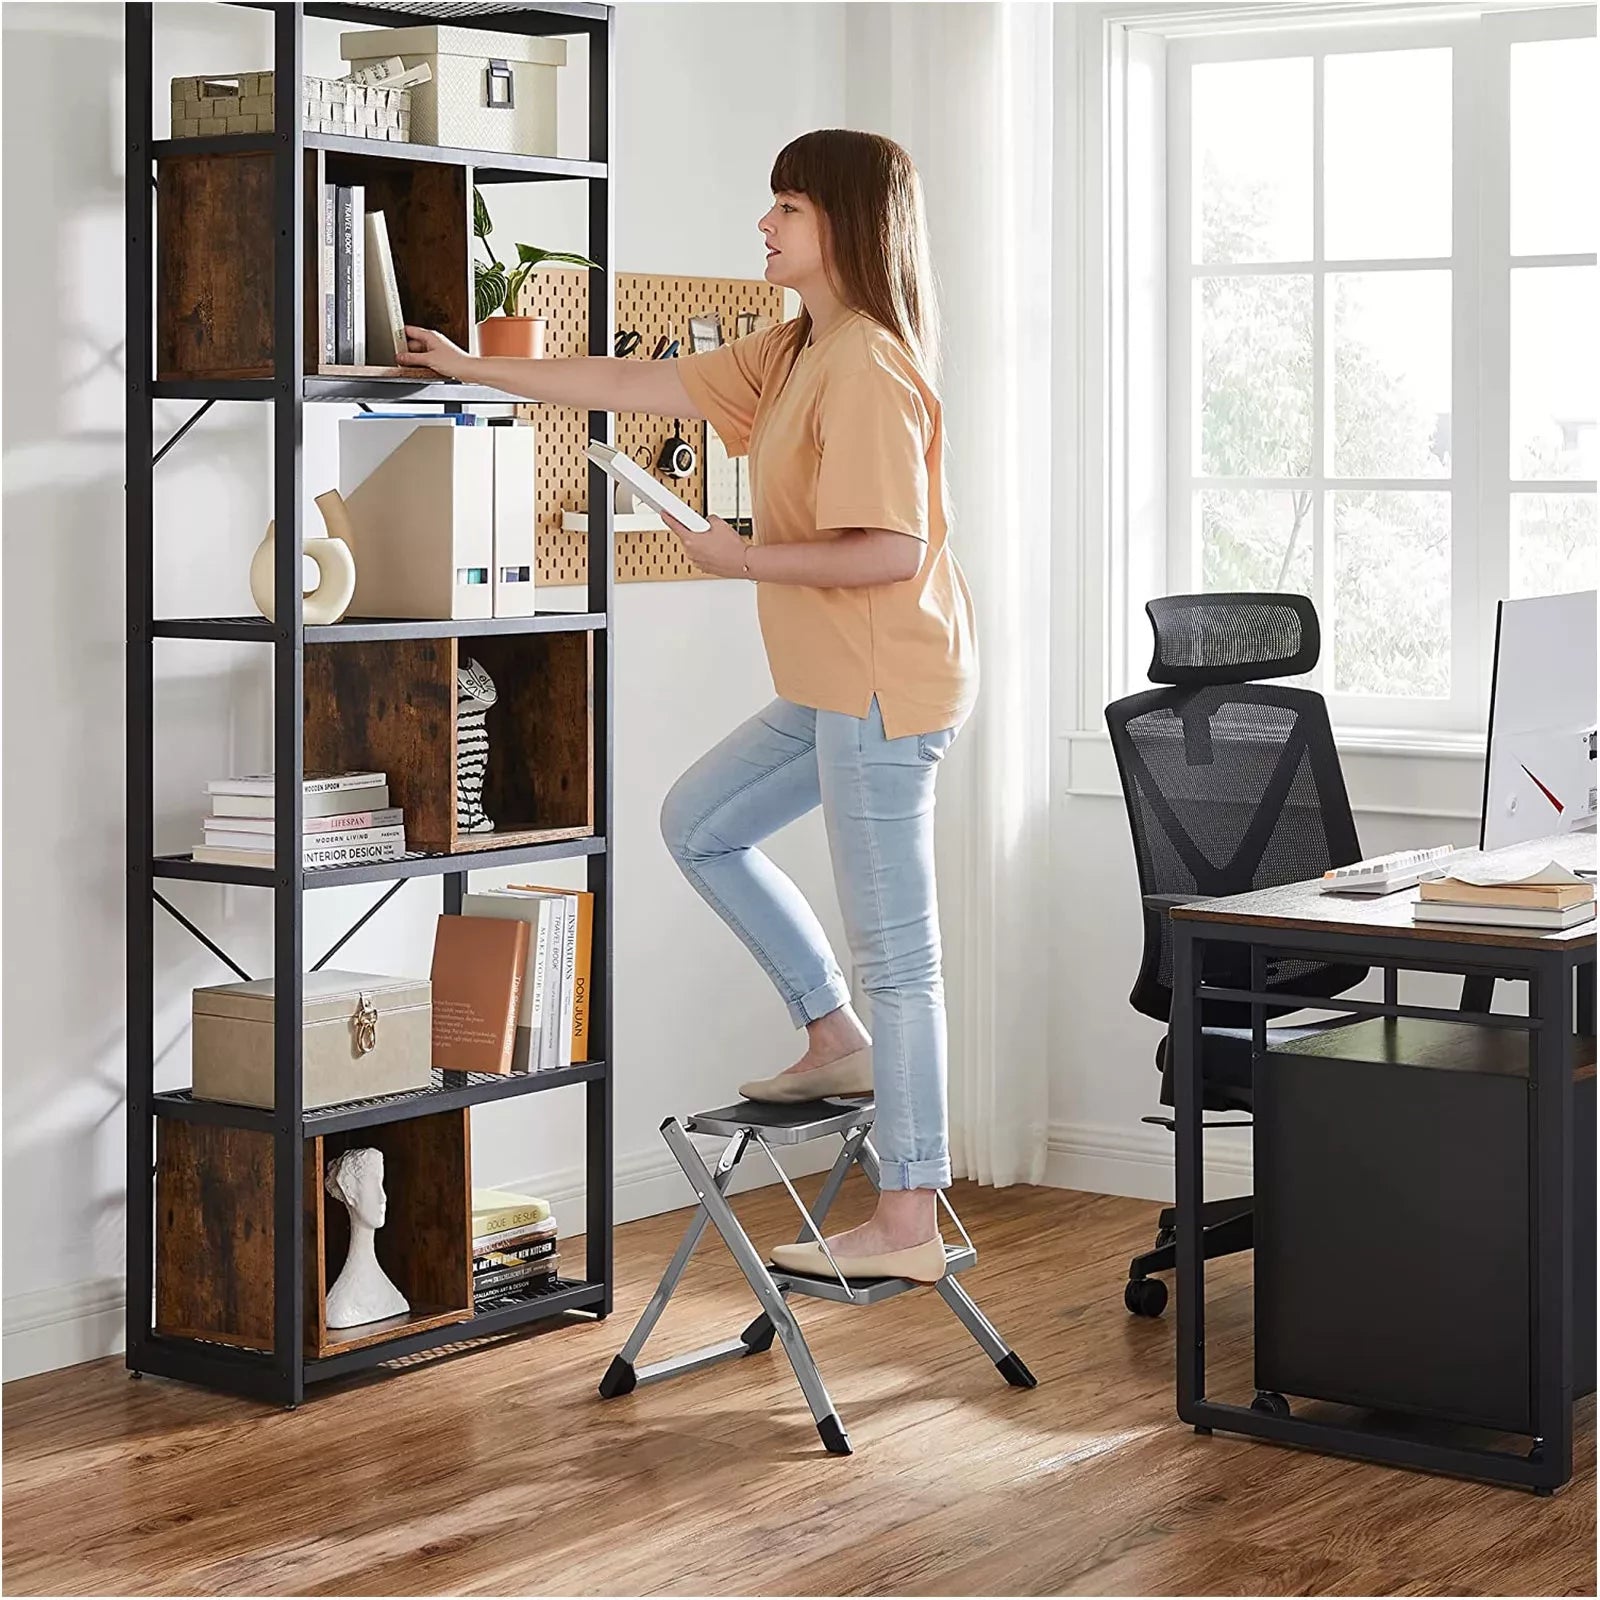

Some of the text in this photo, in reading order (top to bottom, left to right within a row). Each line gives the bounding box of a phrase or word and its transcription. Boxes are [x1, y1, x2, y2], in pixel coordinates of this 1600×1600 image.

[344, 203, 352, 254] TRAVEL BOOK
[304, 785, 324, 793] WOODEN
[324, 783, 340, 791] SPOON
[331, 817, 365, 828] LIFESPAN
[315, 833, 369, 843] MODERN LIVING
[304, 846, 382, 863] INTERIOR DESIGN
[551, 916, 561, 970] TRAVEL BOOK
[566, 914, 575, 980] INSPIRATIONS
[535, 961, 543, 990] YOUR
[574, 977, 584, 1037] DON JUAN
[530, 1242, 552, 1255] KITCHEN
